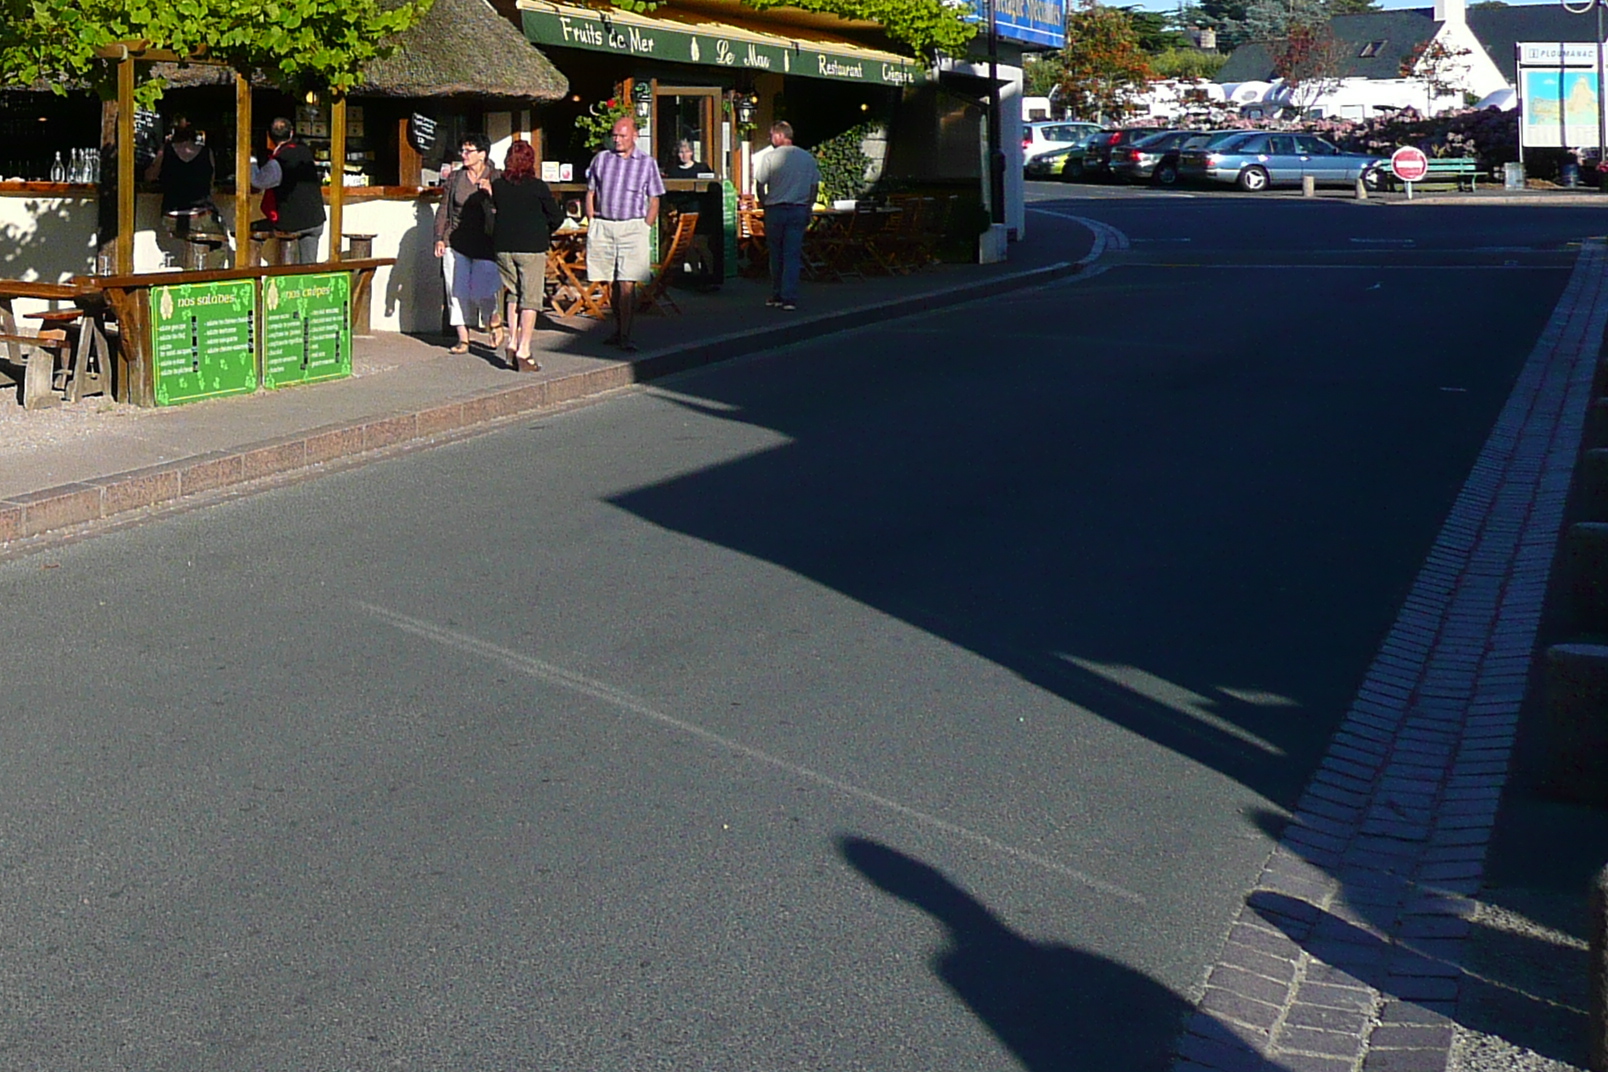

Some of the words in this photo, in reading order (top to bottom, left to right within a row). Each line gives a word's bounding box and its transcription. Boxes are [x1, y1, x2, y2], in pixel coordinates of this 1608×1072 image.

[559, 17, 603, 46] Fruits
[628, 26, 654, 53] Mer
[715, 39, 735, 65] Le
[818, 54, 863, 78] Restaurant
[177, 297, 195, 308] nos
[197, 292, 235, 306] salades
